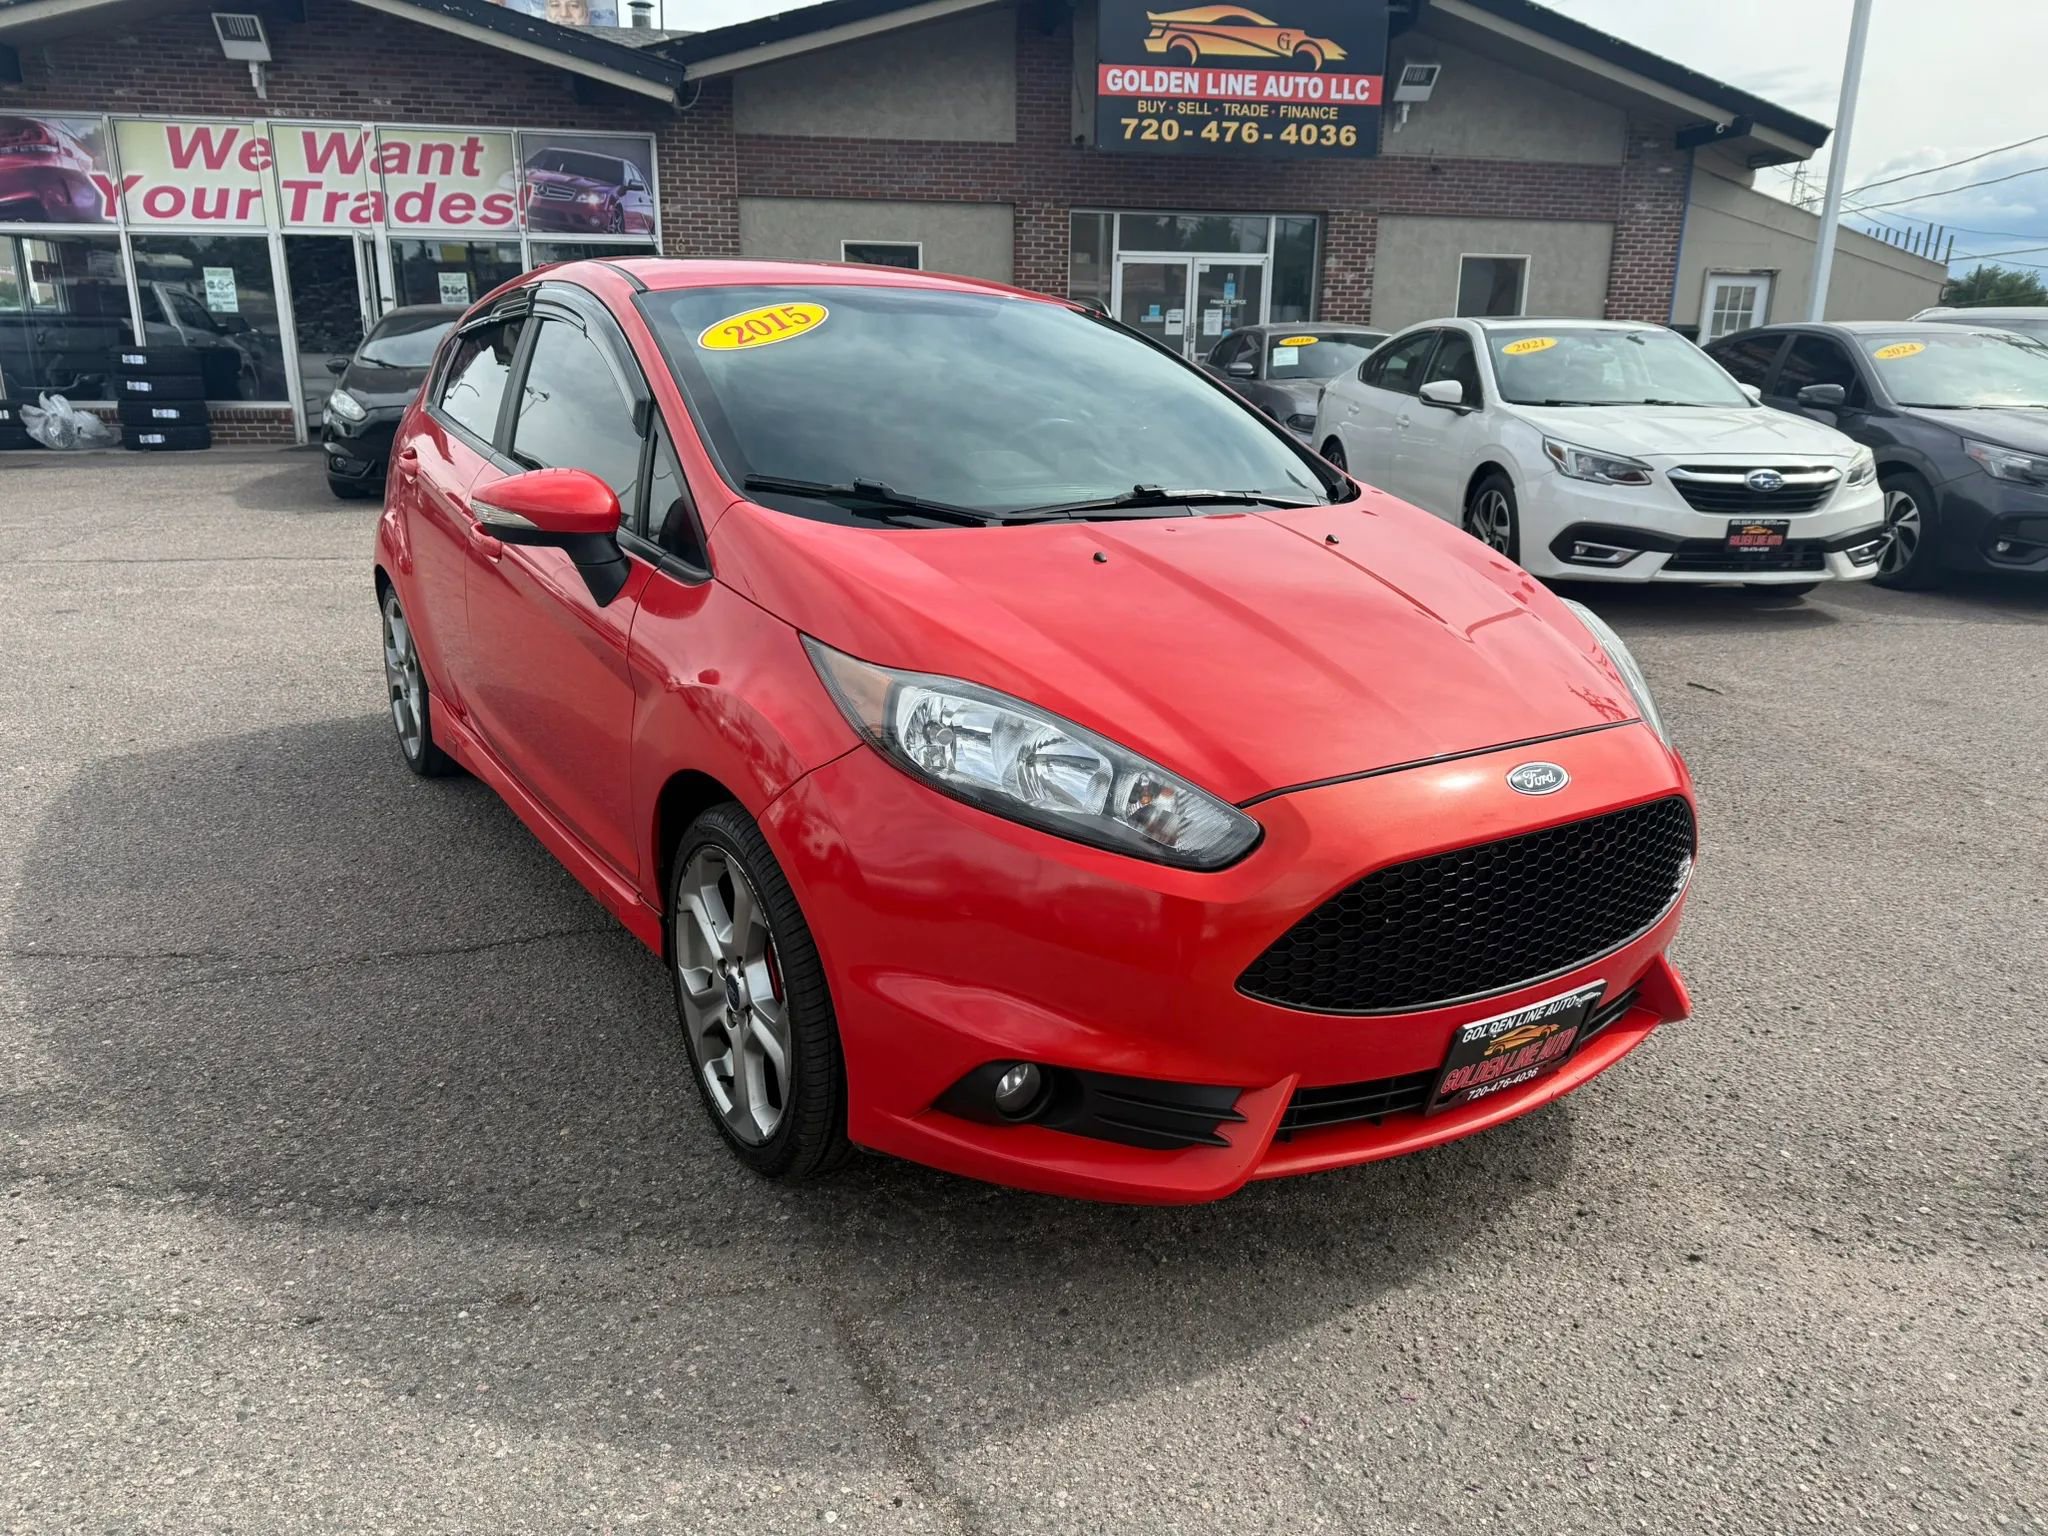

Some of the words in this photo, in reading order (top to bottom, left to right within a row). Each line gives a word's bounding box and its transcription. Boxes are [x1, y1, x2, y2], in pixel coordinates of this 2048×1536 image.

[1106, 69, 1199, 94] GOLDEN
[1206, 73, 1258, 96] LINE
[1263, 75, 1324, 99] AUTO
[1330, 78, 1370, 101] LLC
[1137, 100, 1167, 114] BUY
[1177, 102, 1212, 115] SELL
[1222, 103, 1269, 117] TRADE
[1279, 105, 1339, 119] FINANCE
[166, 126, 272, 172] We
[301, 131, 485, 177] Want
[90, 174, 263, 220] Your
[281, 180, 533, 225] Trades!
[723, 306, 812, 345] 2015
[1513, 338, 1546, 352] 2021
[1884, 343, 1917, 358] 2024
[1522, 768, 1556, 788] Ford
[1462, 1018, 1515, 1043] GOLDEN
[1515, 1005, 1547, 1025] LINE
[1545, 995, 1578, 1017] AUTO
[1441, 1052, 1509, 1094] GOLDEN
[1507, 1041, 1543, 1073] LINE
[1538, 1026, 1578, 1062] AUTO
[1467, 1067, 1539, 1101] 720-476-4036
